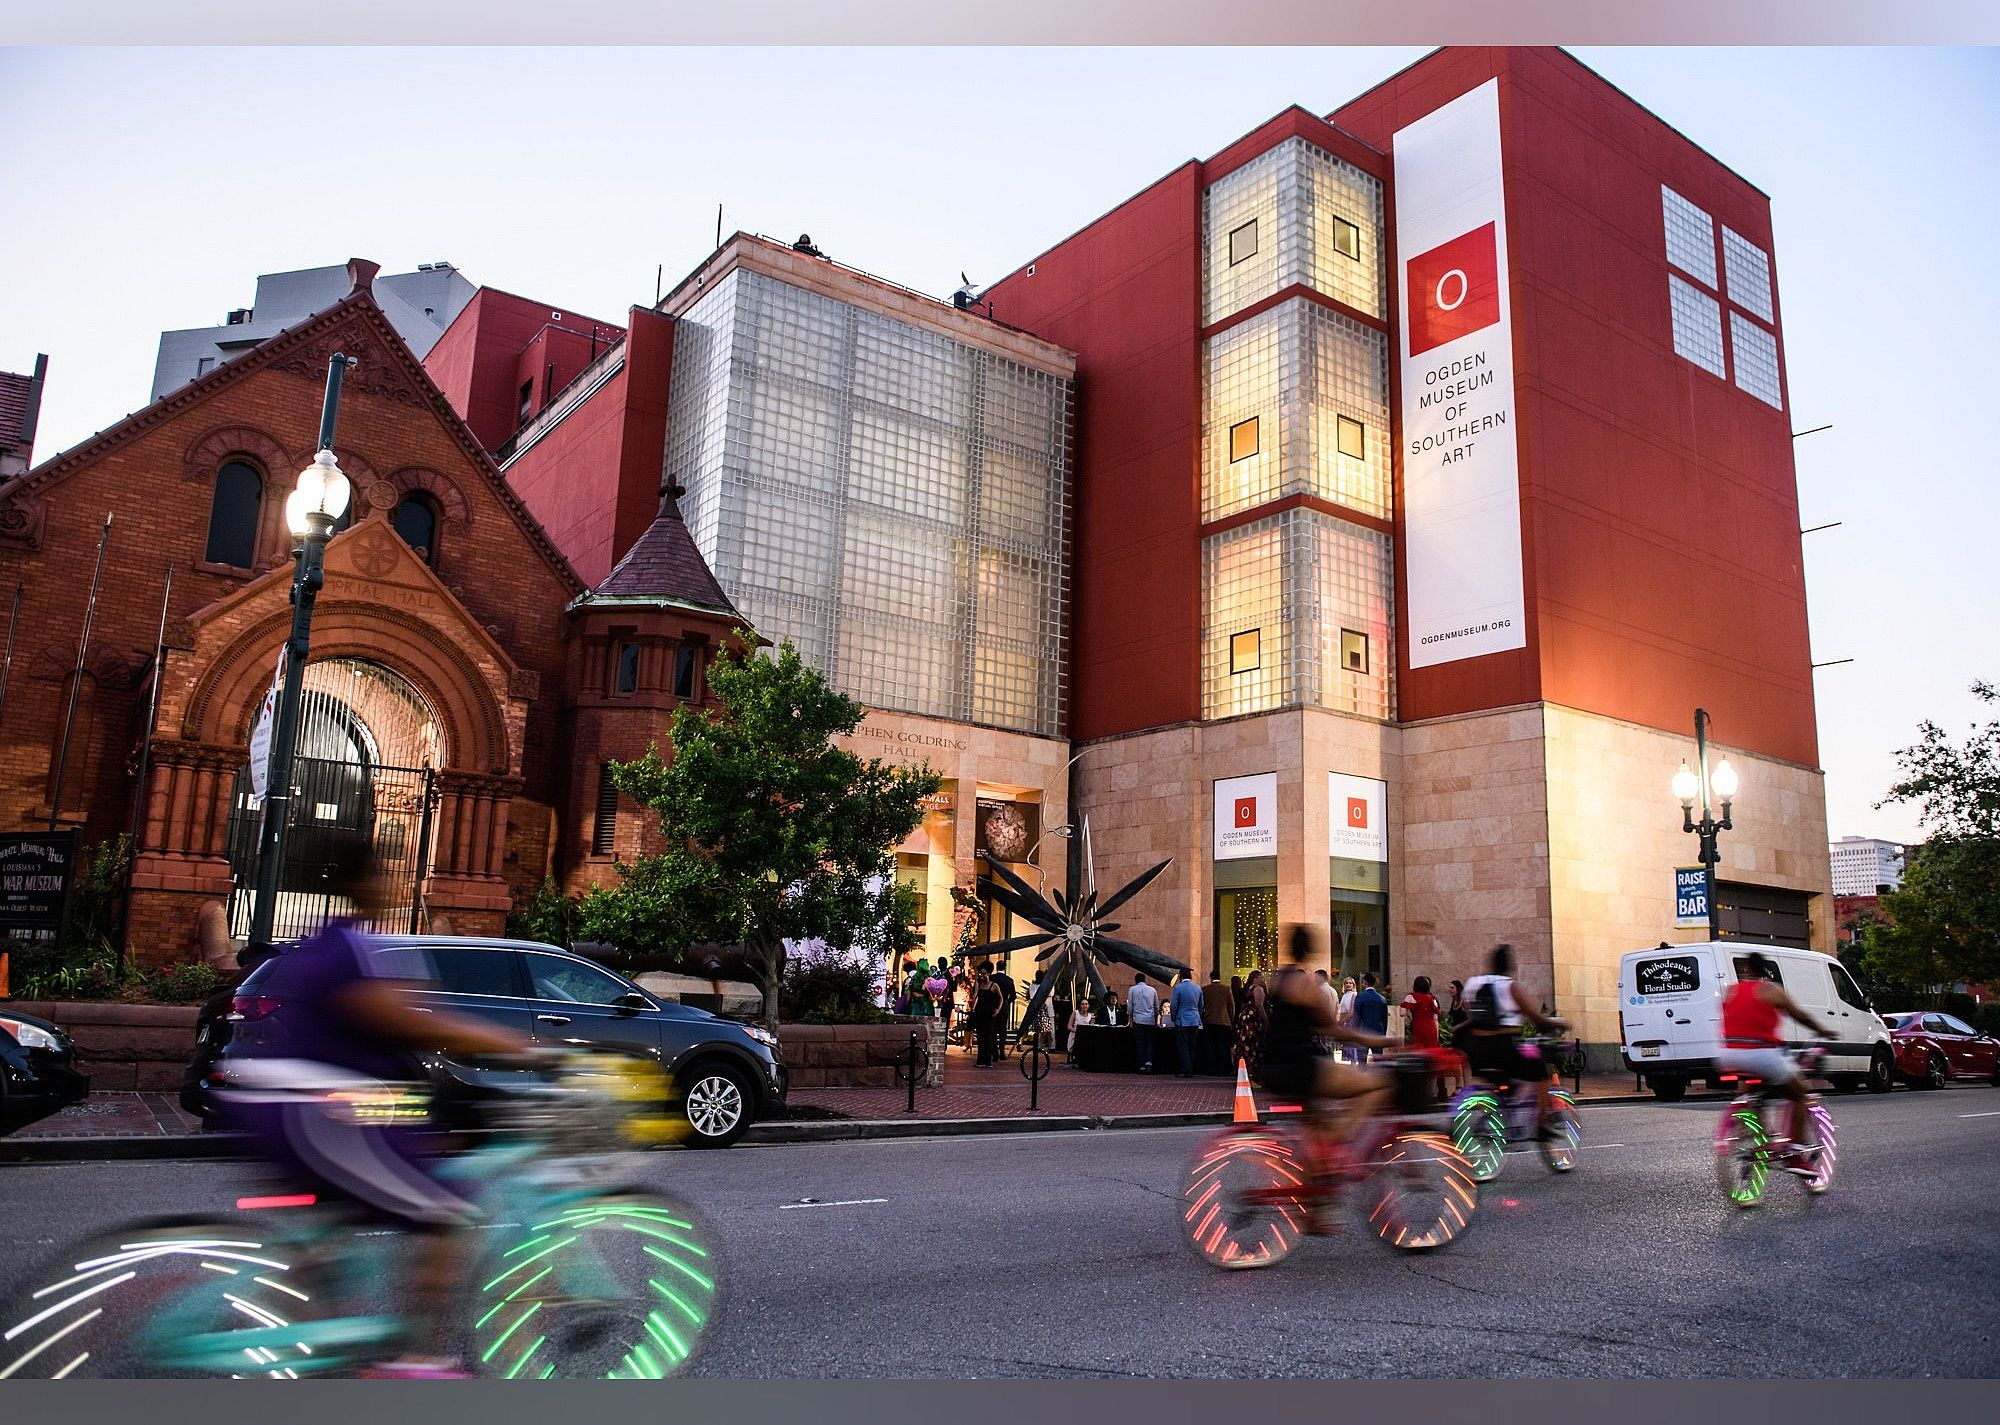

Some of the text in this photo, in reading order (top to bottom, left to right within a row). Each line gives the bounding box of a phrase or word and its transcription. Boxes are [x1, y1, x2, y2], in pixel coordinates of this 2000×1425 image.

[1436, 269, 1467, 311] O
[1425, 351, 1486, 385] OGDEN
[1420, 370, 1493, 410] MUSEUM
[1445, 402, 1467, 421] OF
[1411, 410, 1506, 455] SOUTHERN
[1442, 443, 1475, 466] ART
[393, 590, 436, 609] HALL
[1421, 619, 1511, 645] OGDENMUSEUM.ORG
[857, 725, 967, 750] PHEN GOLDRING
[884, 745, 919, 758] HALL
[1241, 806, 1250, 819] O
[1353, 806, 1362, 820] O
[1222, 829, 1269, 840] OGDEN MUSEUM
[1229, 838, 1259, 846] SOUTHERN
[1260, 836, 1272, 844] ART
[1337, 829, 1379, 840] OGDEN MUSEUM
[1343, 838, 1371, 847] SOUTHERN
[3, 875, 63, 892] WAR MUSEUM
[1678, 871, 1706, 886] RAISE
[1678, 895, 1707, 915] BAR
[1641, 960, 1693, 979] Thibodeaux's
[1644, 981, 1692, 993] Floral Studio
